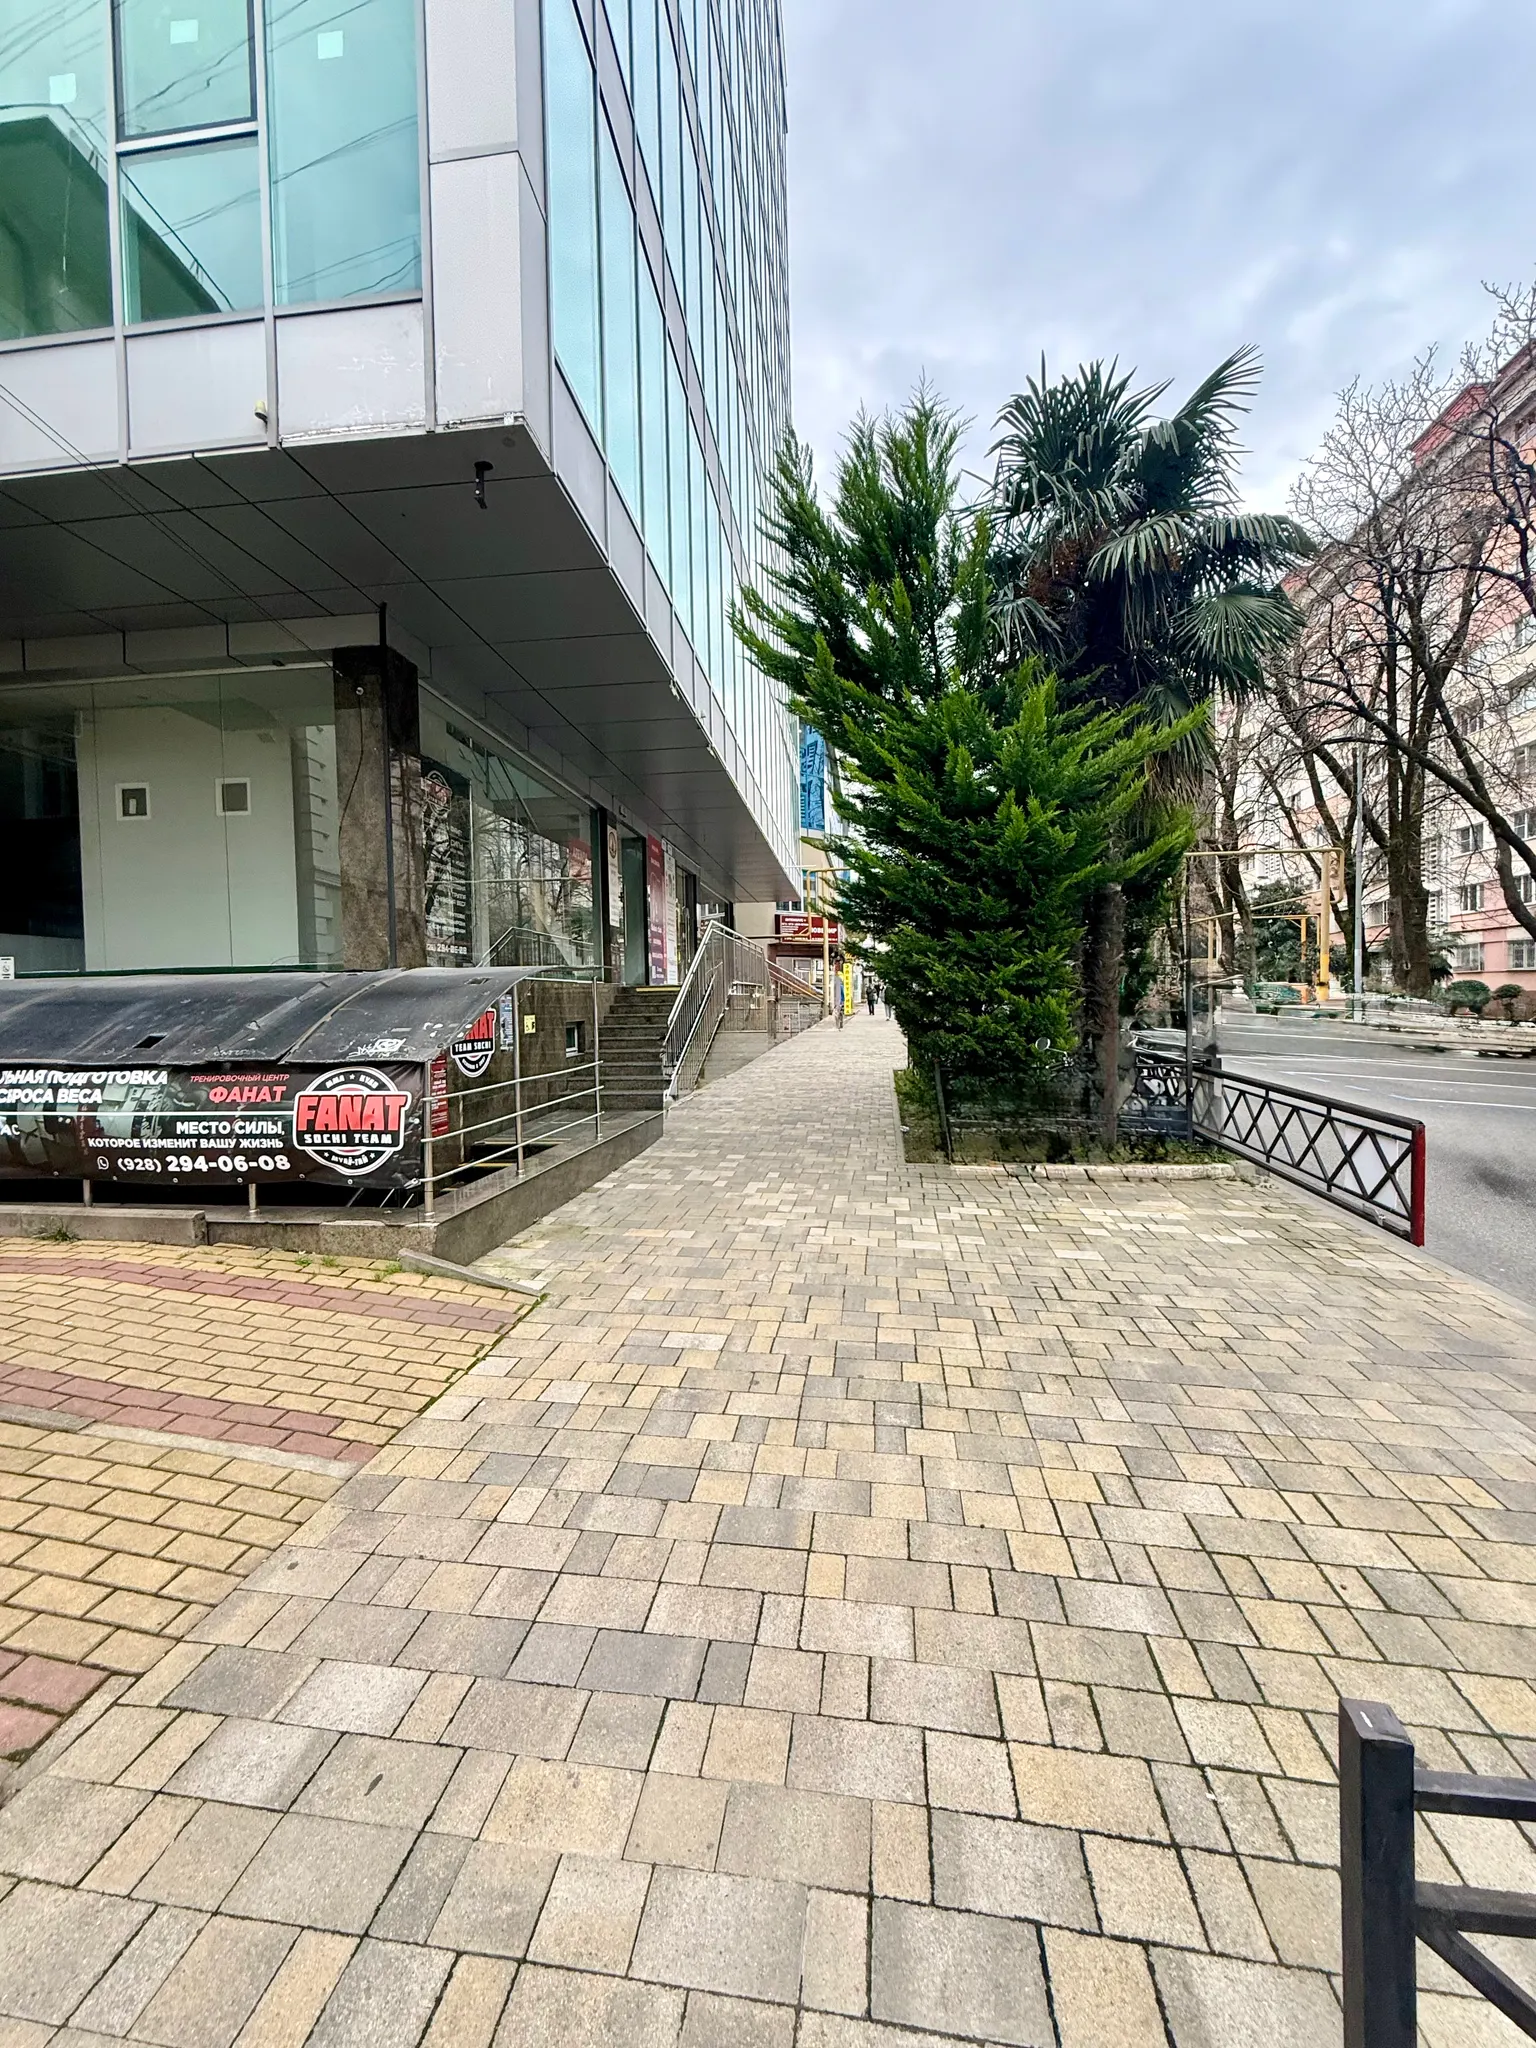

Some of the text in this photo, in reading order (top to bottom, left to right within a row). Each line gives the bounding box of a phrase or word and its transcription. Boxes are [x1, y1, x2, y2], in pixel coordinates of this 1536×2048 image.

[454, 1040, 491, 1052] TEAM SOCHI
[190, 1073, 290, 1083] ТРЕНИРОВОЧНЫЙ ЦЕНТР
[56, 1088, 103, 1104] ВЕСА
[208, 1086, 287, 1103] ФАНАТ
[297, 1095, 408, 1131] FANAT
[176, 1120, 286, 1136] МЕСТО СИЛЫ,
[87, 1138, 284, 1149] КОТОРОЕ ИЗМЕНИТ ВАШУ ЖИЗНЬ
[303, 1133, 393, 1144] SOCHI TEAM
[117, 1154, 292, 1173] (928) 294-06-08
